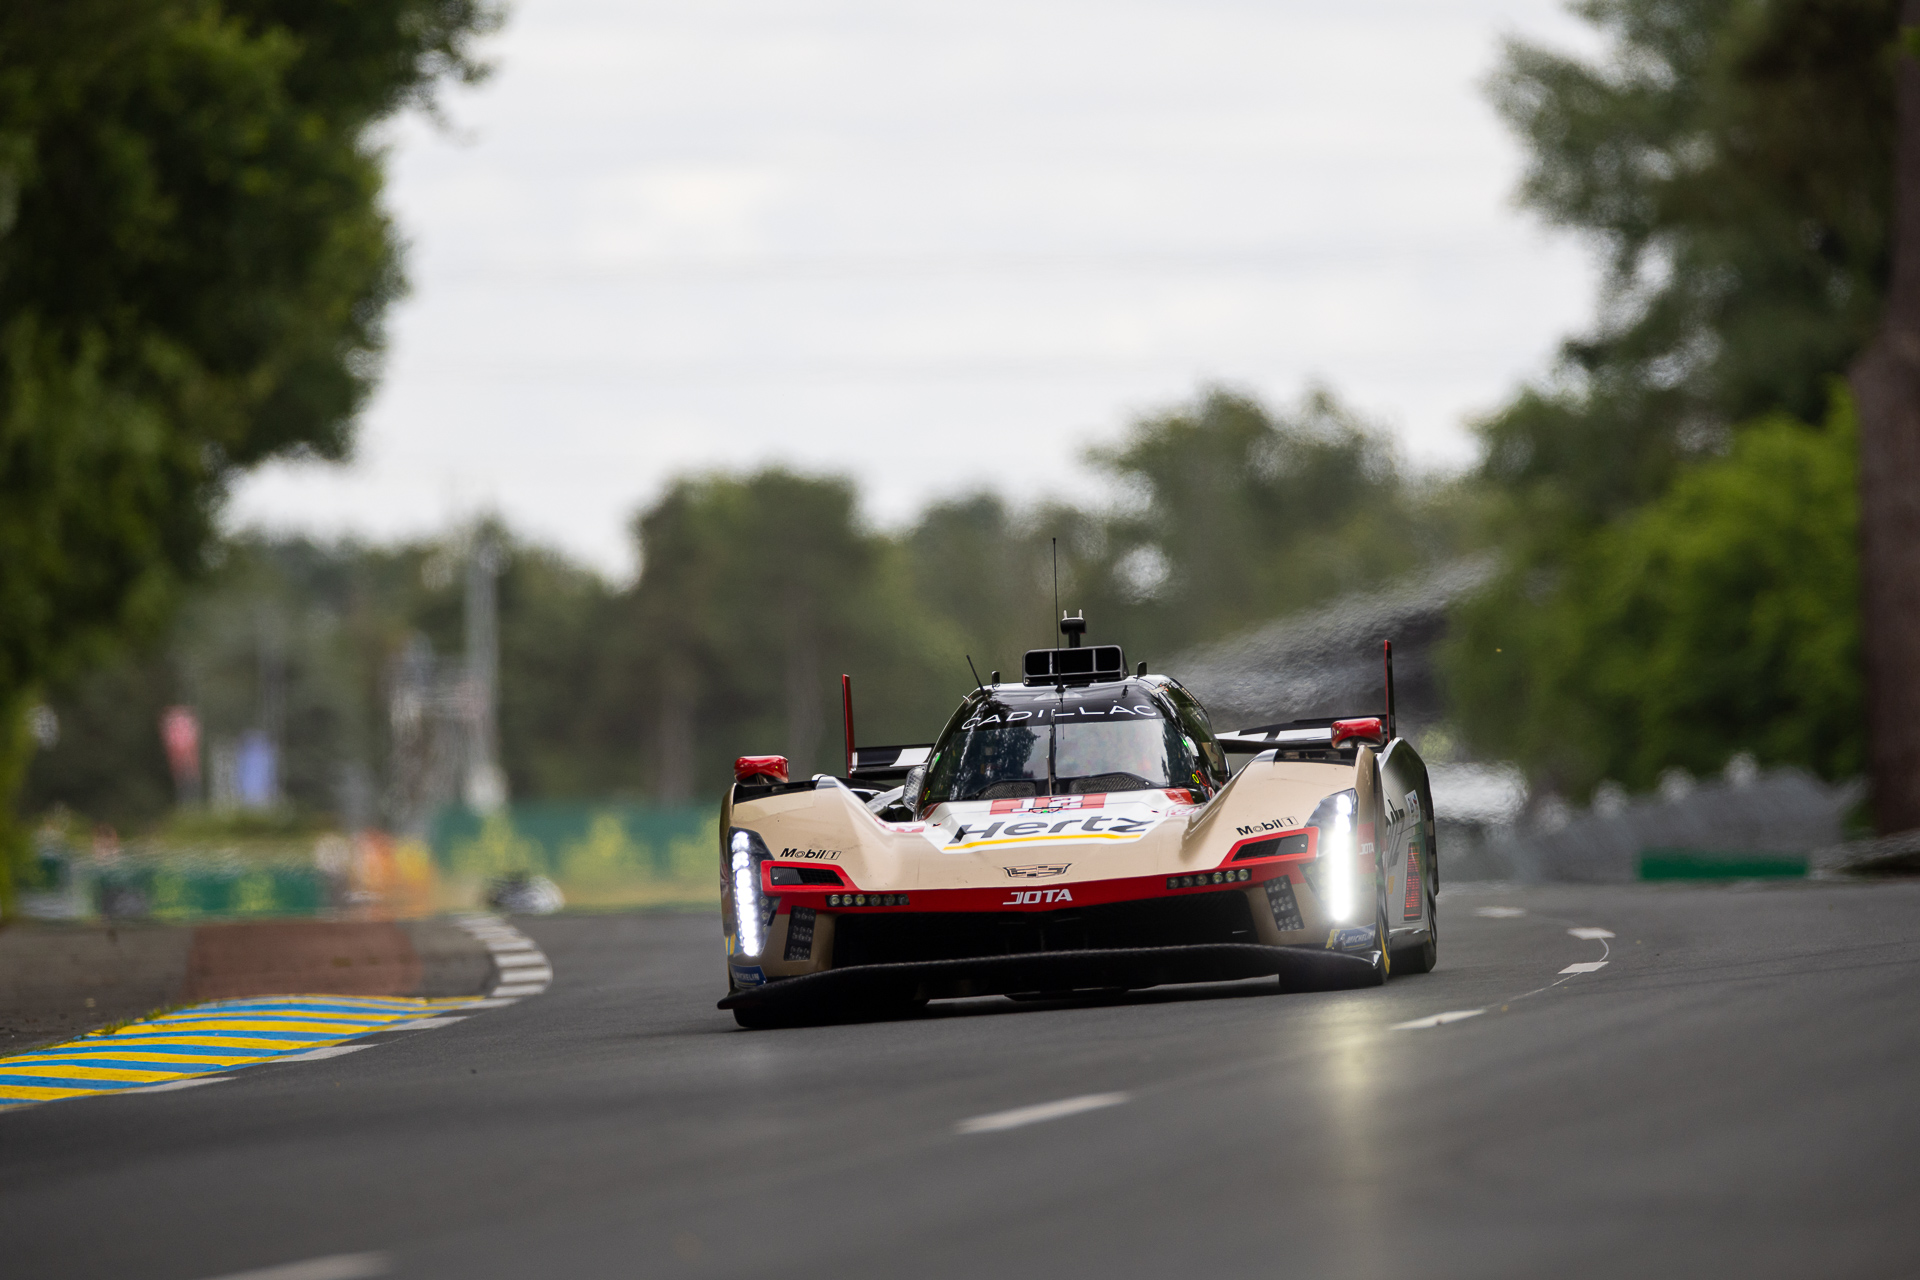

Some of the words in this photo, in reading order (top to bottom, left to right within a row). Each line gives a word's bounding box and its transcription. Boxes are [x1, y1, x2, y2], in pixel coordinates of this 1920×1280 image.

[961, 705, 1157, 730] CADILLAC
[948, 815, 1154, 844] Hertz
[1236, 818, 1283, 836] Mobil
[779, 847, 827, 860] Mobil
[1002, 888, 1073, 906] JOTA
